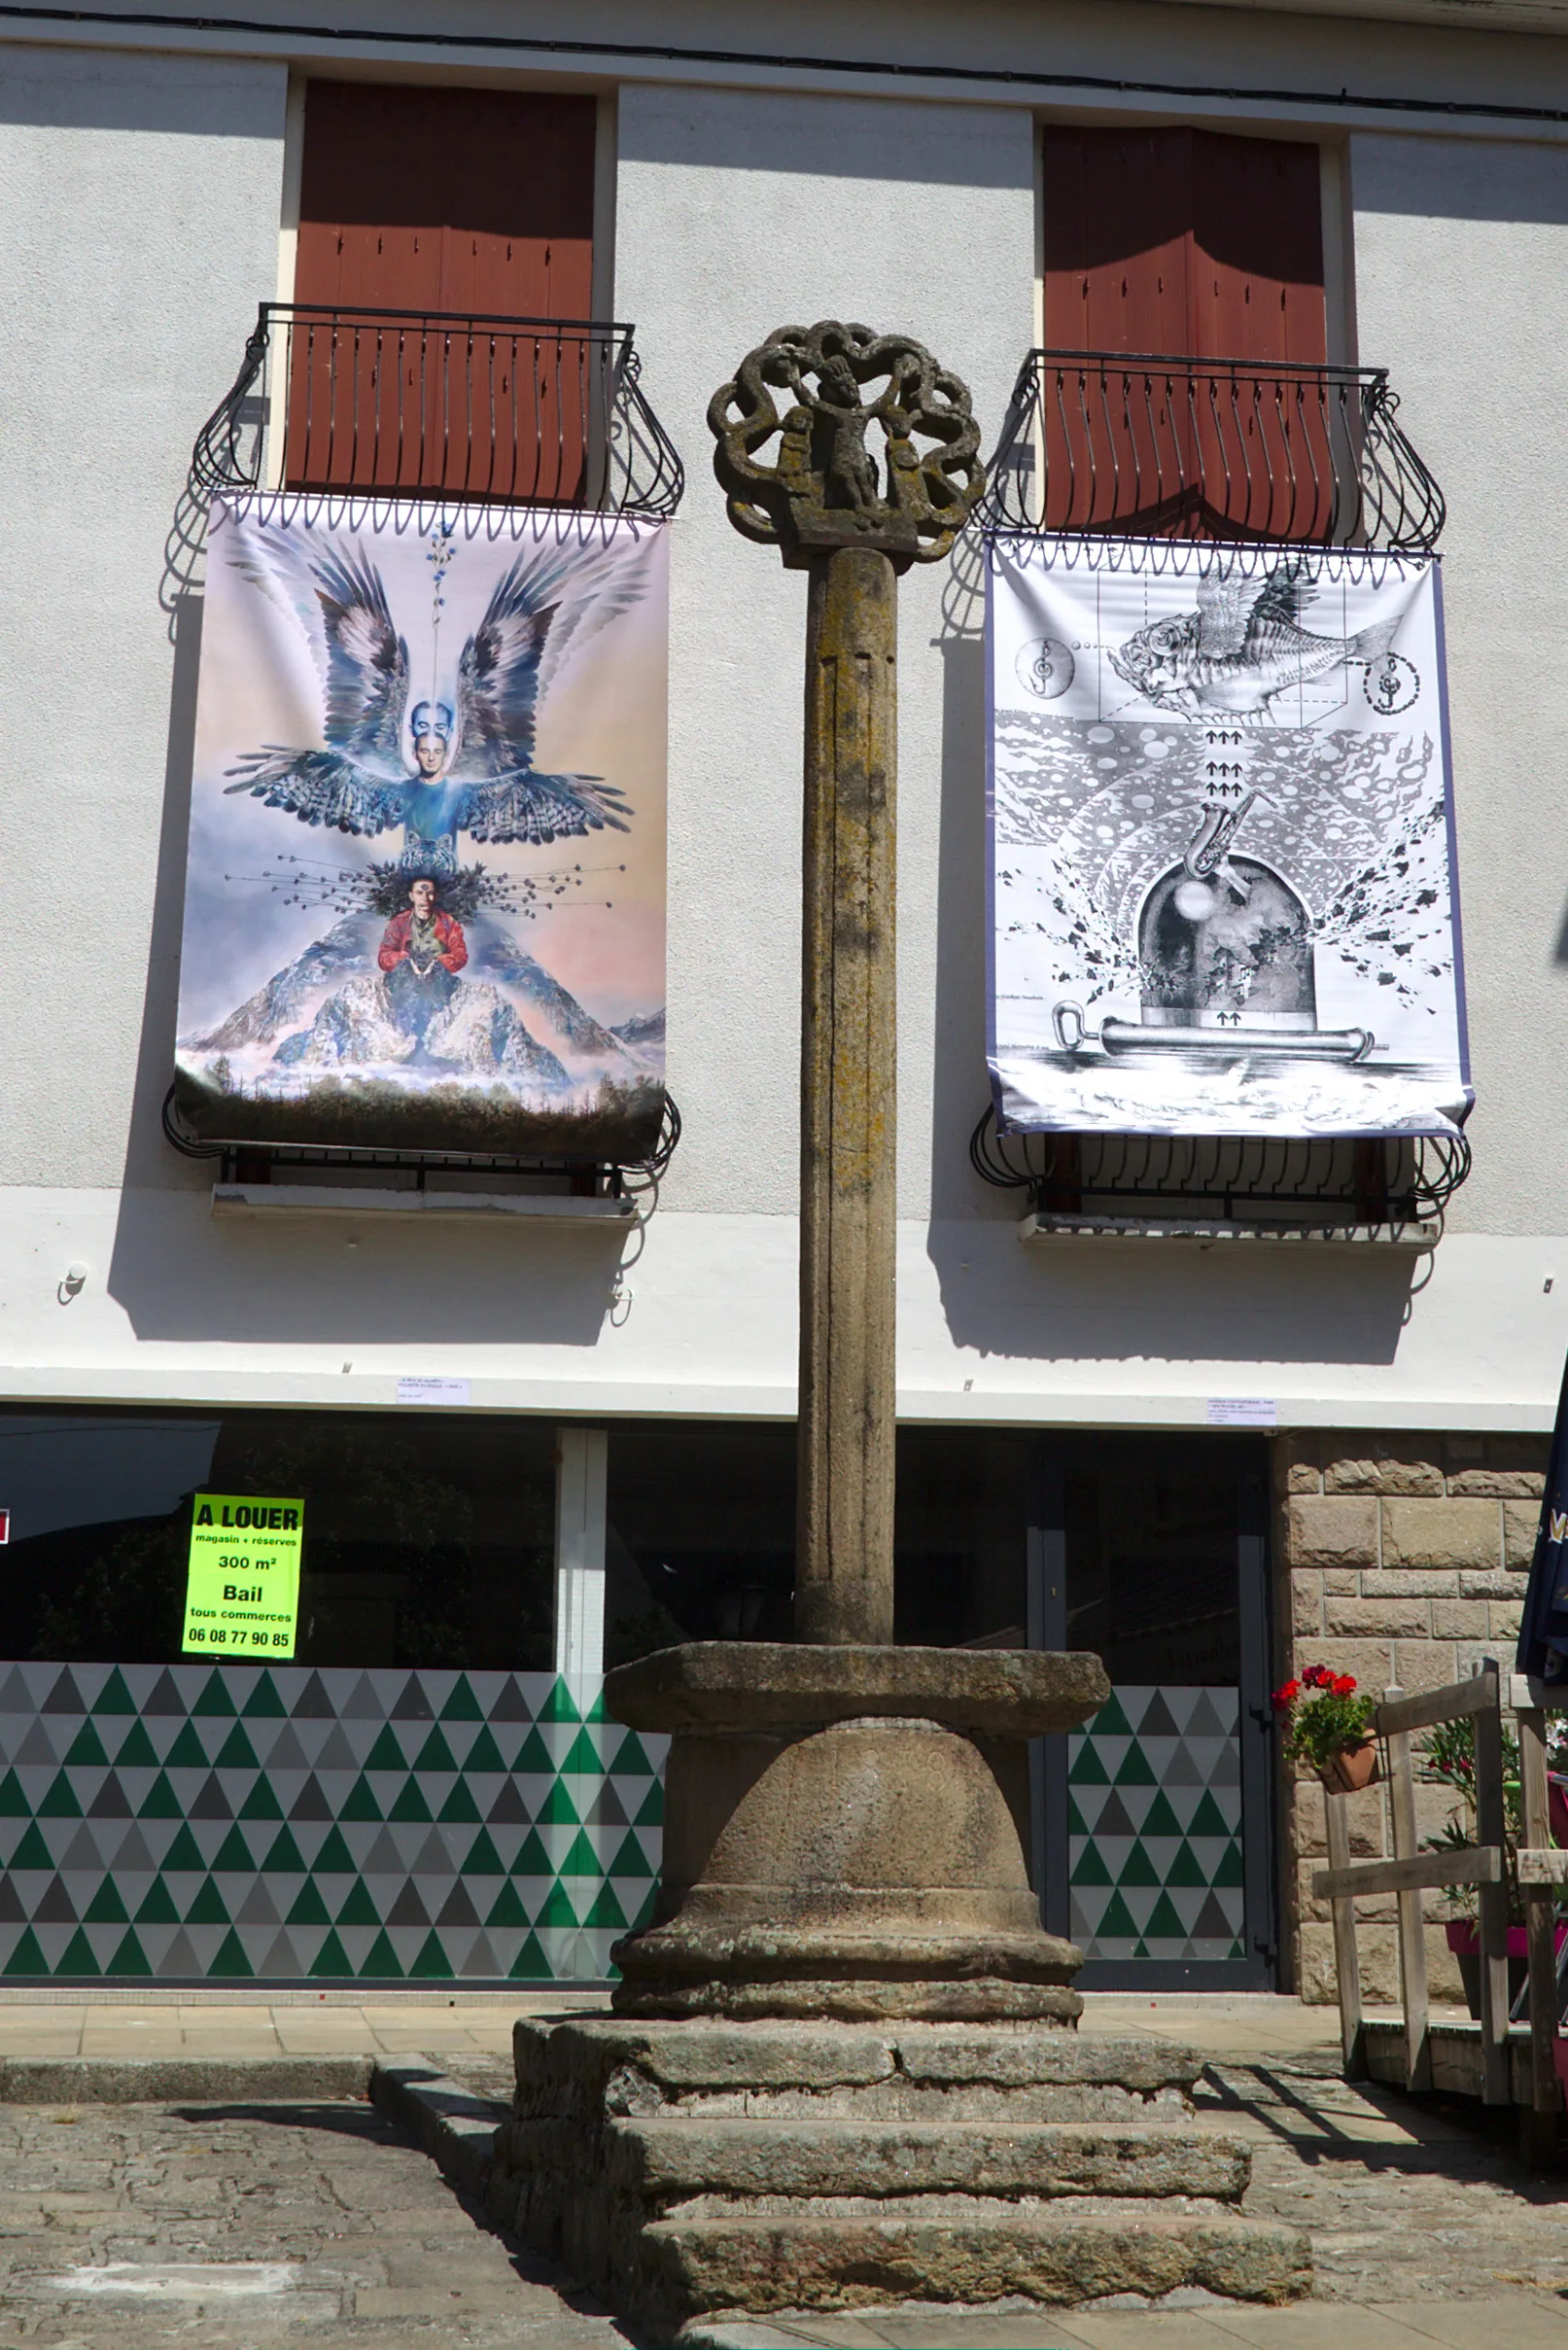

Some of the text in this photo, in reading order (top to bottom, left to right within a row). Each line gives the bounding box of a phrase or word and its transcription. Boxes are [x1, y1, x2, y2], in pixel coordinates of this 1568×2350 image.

[195, 1503, 298, 1531] A LOUER
[195, 1534, 239, 1544] magasin
[252, 1536, 296, 1546] réserves
[219, 1556, 250, 1569] 300
[223, 1584, 262, 1602] Bail
[191, 1606, 292, 1623] tous commerces
[189, 1628, 290, 1647] 06 08 77 90 85
